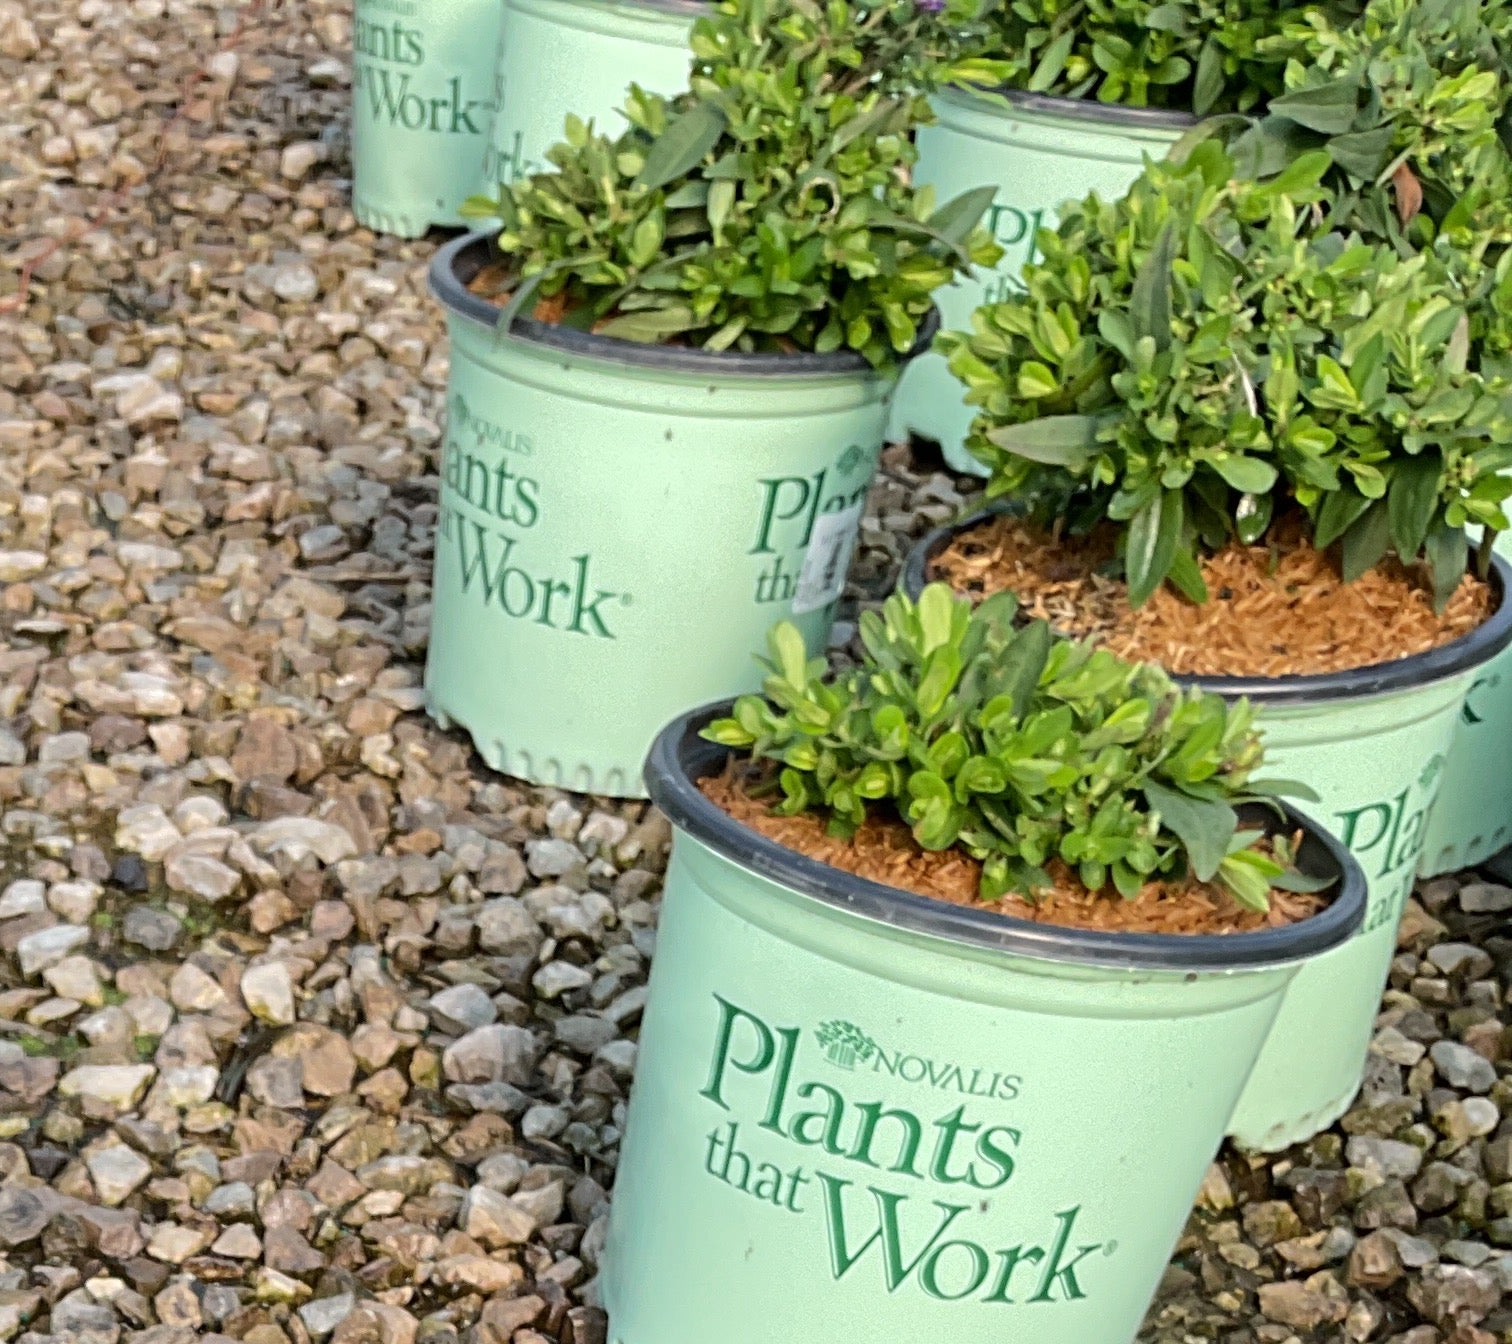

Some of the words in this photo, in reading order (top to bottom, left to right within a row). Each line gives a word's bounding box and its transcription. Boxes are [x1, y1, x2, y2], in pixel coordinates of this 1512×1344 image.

[361, 65, 482, 135] Work
[445, 441, 540, 528] ants
[699, 992, 1022, 1190] Plants
[872, 1045, 1024, 1101] NOVALIS
[705, 1122, 813, 1213] that
